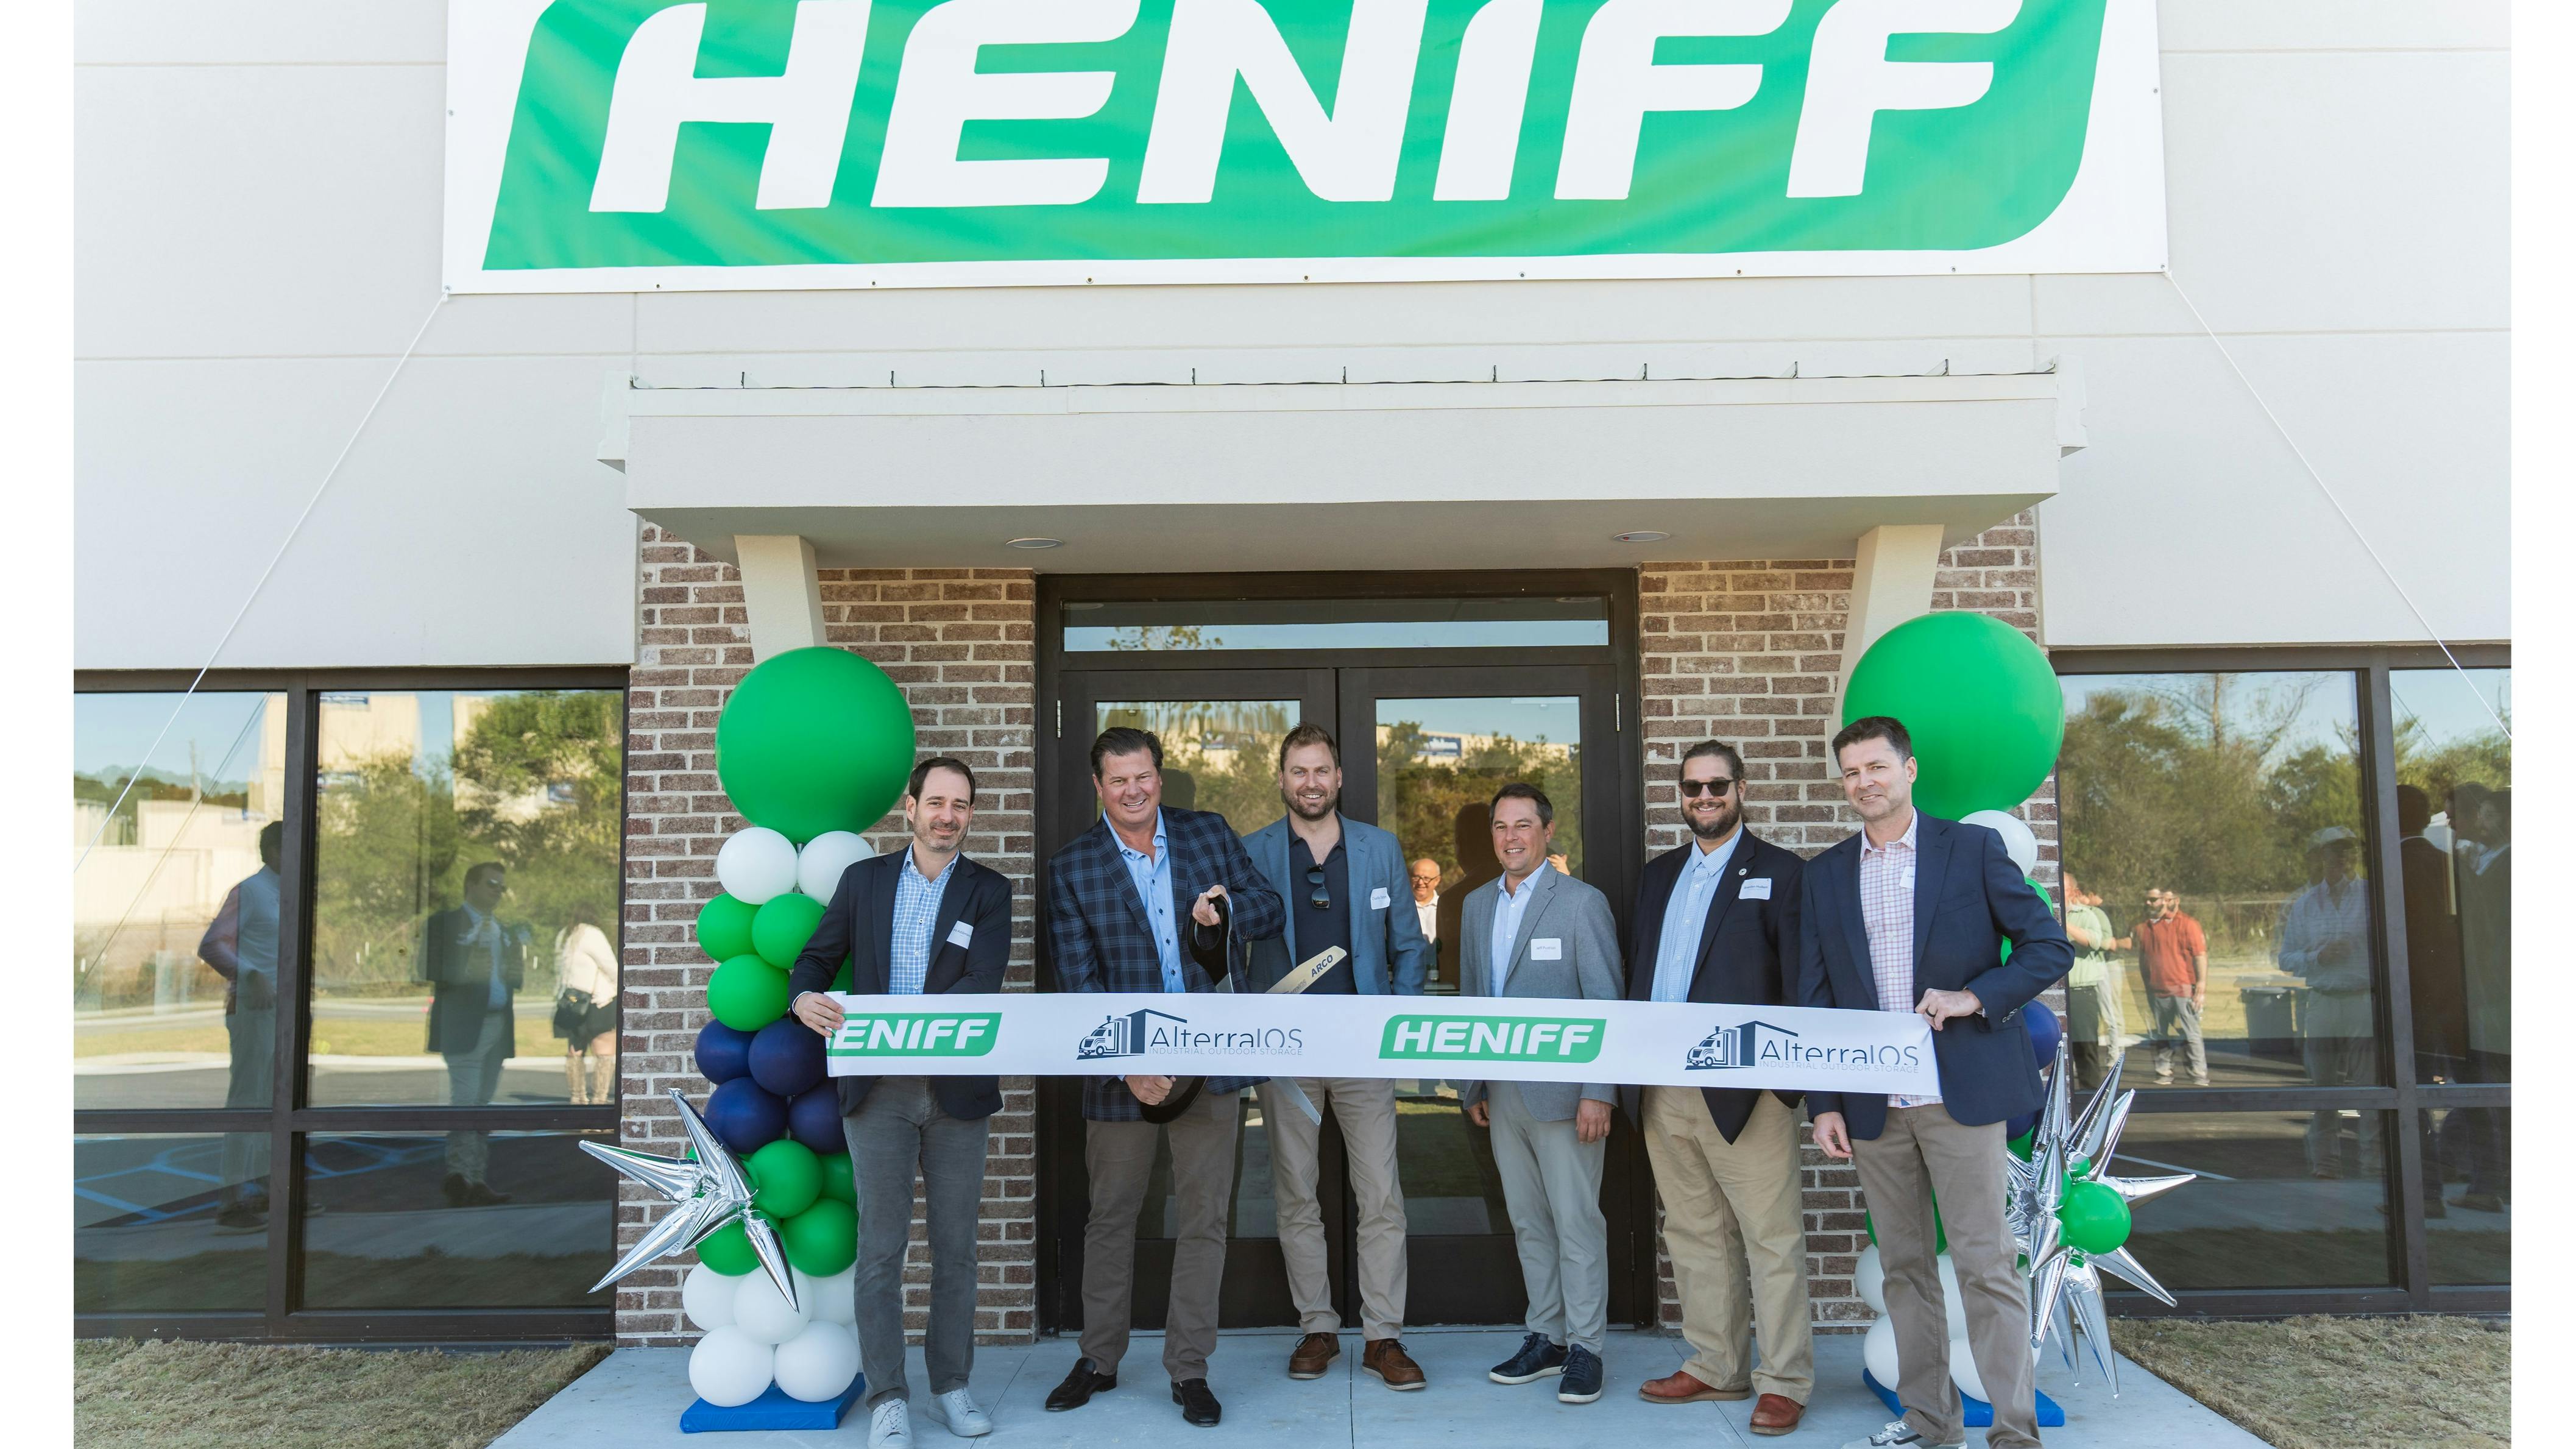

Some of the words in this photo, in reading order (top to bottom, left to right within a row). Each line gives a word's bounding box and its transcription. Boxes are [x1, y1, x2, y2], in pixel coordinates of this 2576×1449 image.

[589, 0, 2023, 213] HENIFF
[1311, 954, 1333, 977] ARCO
[826, 1019, 990, 1049] ENIFF
[1150, 1026, 1303, 1047] AlterraIOS
[1393, 1021, 1594, 1055] HENIFF
[1761, 1040, 1919, 1066] AlterraIOS
[1760, 1061, 1818, 1070] INDUSTRIAL
[1821, 1063, 1871, 1072] OUTDOOR
[1874, 1065, 1919, 1074] STORAGE
